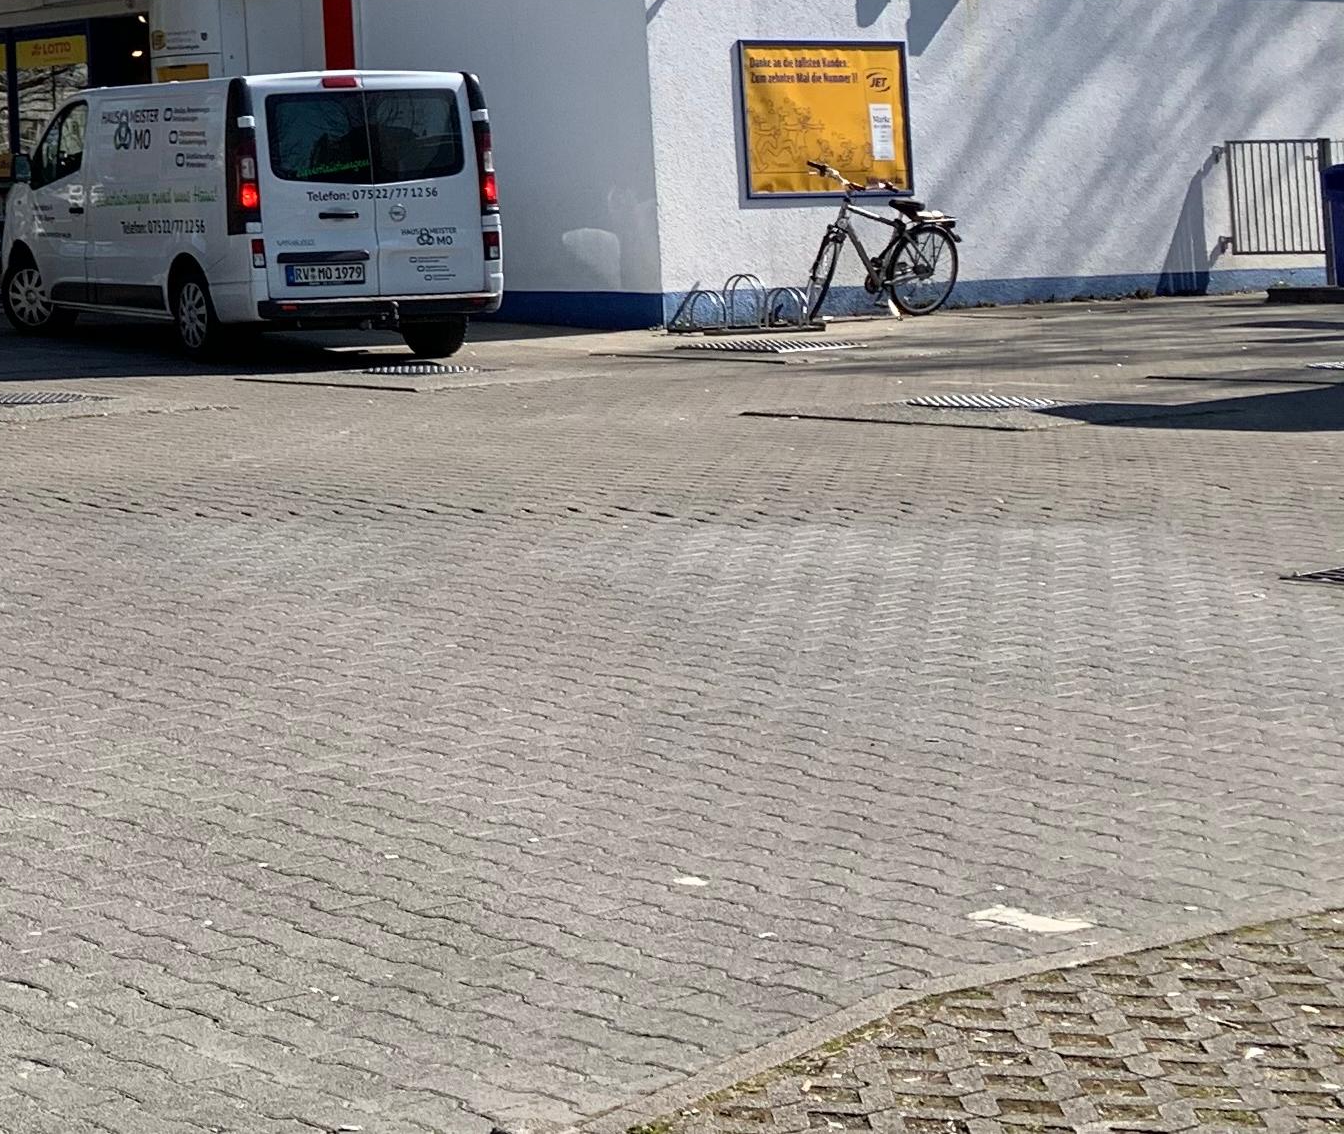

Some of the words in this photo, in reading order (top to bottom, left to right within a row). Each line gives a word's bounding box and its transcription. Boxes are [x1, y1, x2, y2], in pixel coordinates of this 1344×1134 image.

[42, 41, 71, 56] LOTTO
[750, 57, 772, 68] Danke
[869, 77, 887, 88] JET
[134, 129, 151, 150] MO
[307, 191, 350, 201] Telefon:
[436, 235, 453, 245] MO
[295, 268, 311, 281] RV
[318, 267, 332, 280] MO
[336, 266, 362, 279] 1979
